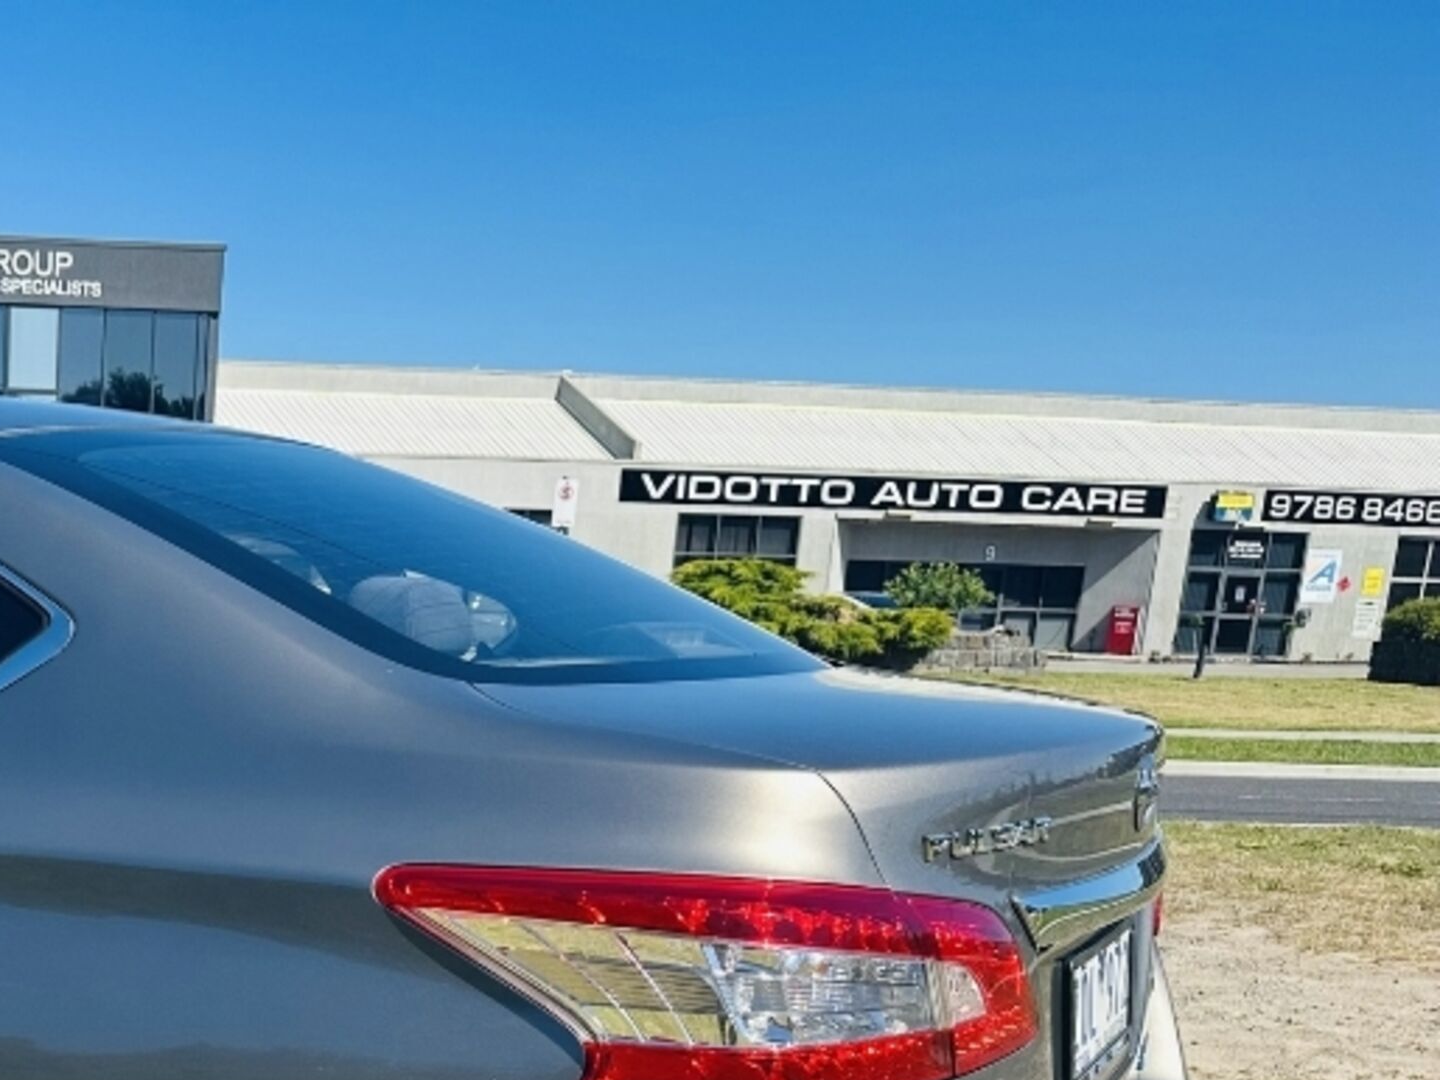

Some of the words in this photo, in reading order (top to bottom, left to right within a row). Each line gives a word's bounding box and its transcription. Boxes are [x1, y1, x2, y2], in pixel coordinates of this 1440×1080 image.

[0, 277, 102, 297] SPECIALISTS
[641, 473, 855, 506] VIDOTTO
[871, 480, 1004, 510] AUTO
[1021, 485, 1147, 514] CARE
[1269, 494, 1357, 520] 9786
